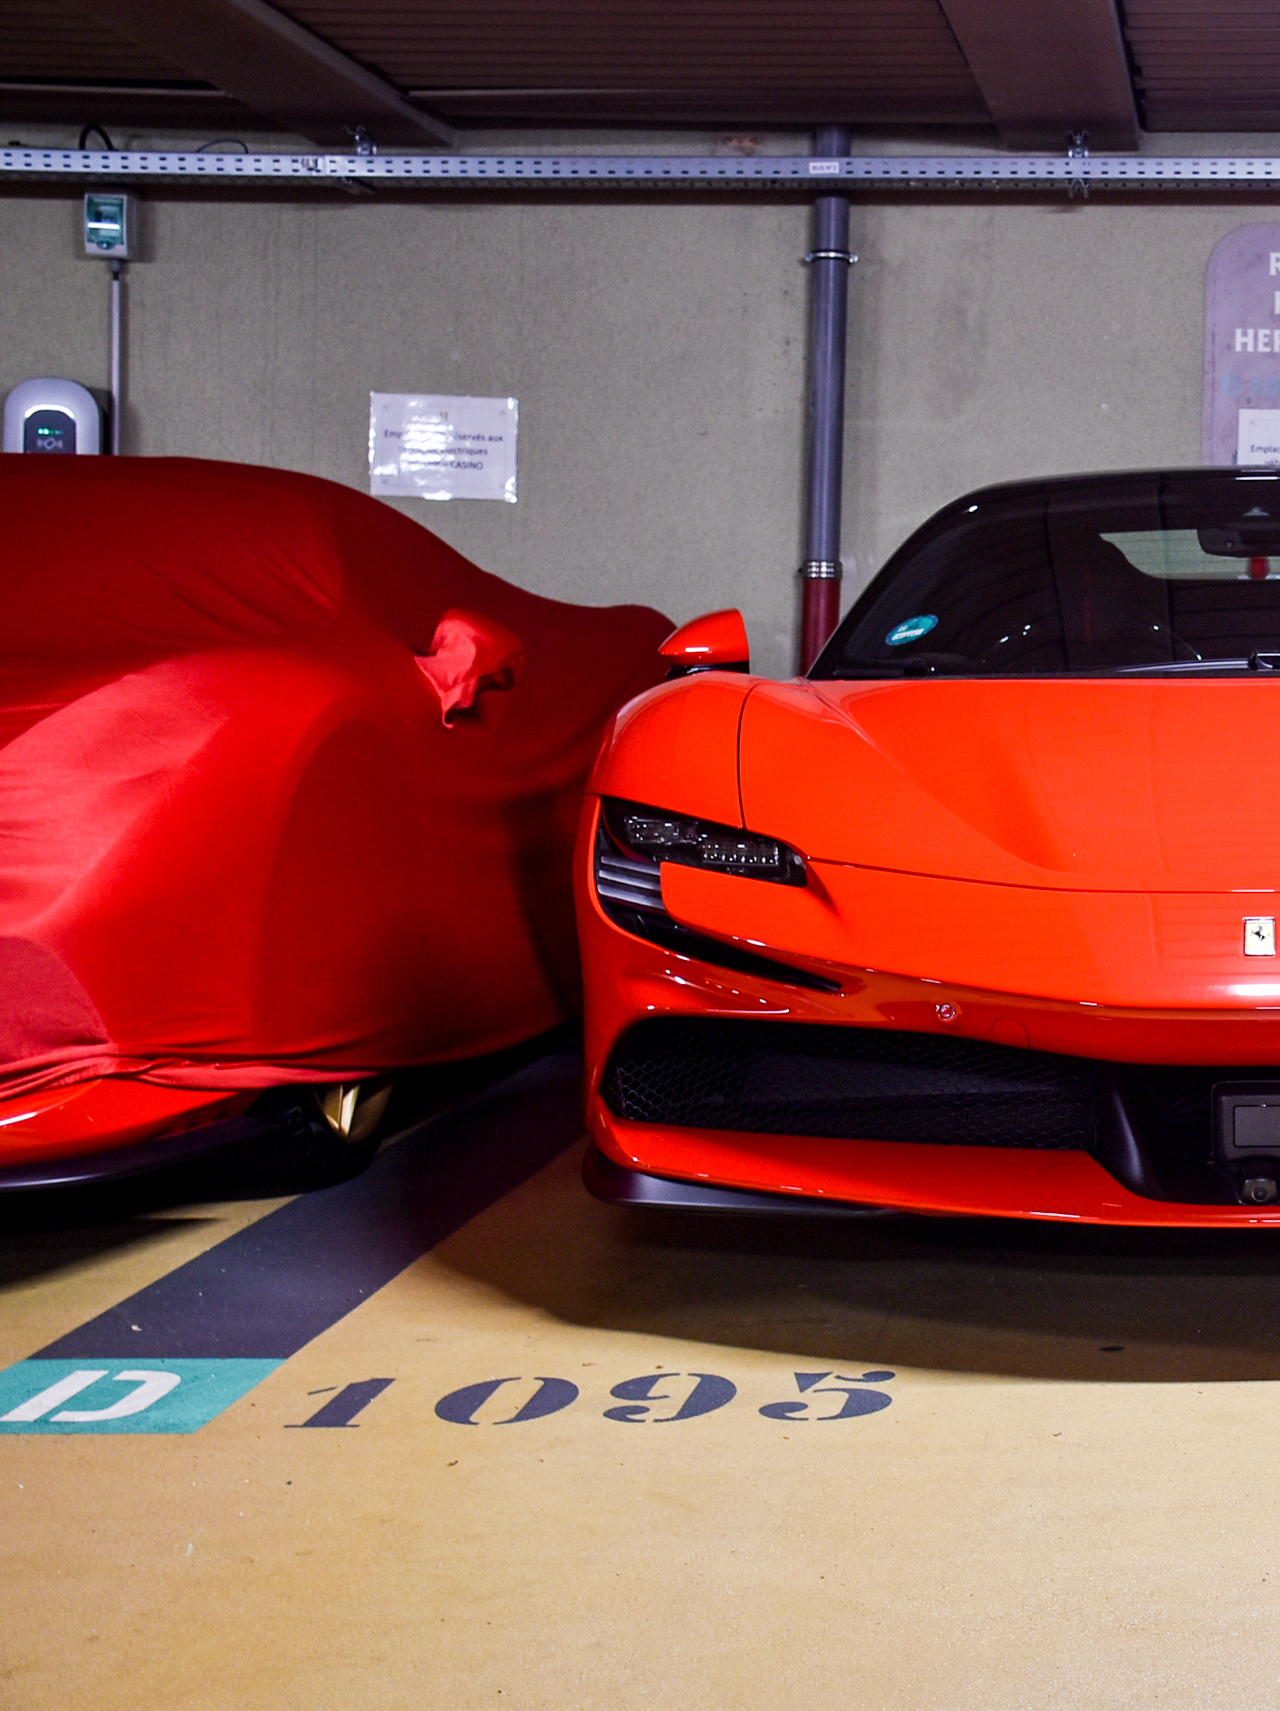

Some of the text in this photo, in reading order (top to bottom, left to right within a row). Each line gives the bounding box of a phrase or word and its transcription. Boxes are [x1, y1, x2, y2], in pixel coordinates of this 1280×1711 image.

[488, 434, 503, 442] aux
[450, 460, 484, 470] CASINO
[0, 1370, 182, 1422] D
[284, 1369, 894, 1428] 1095
